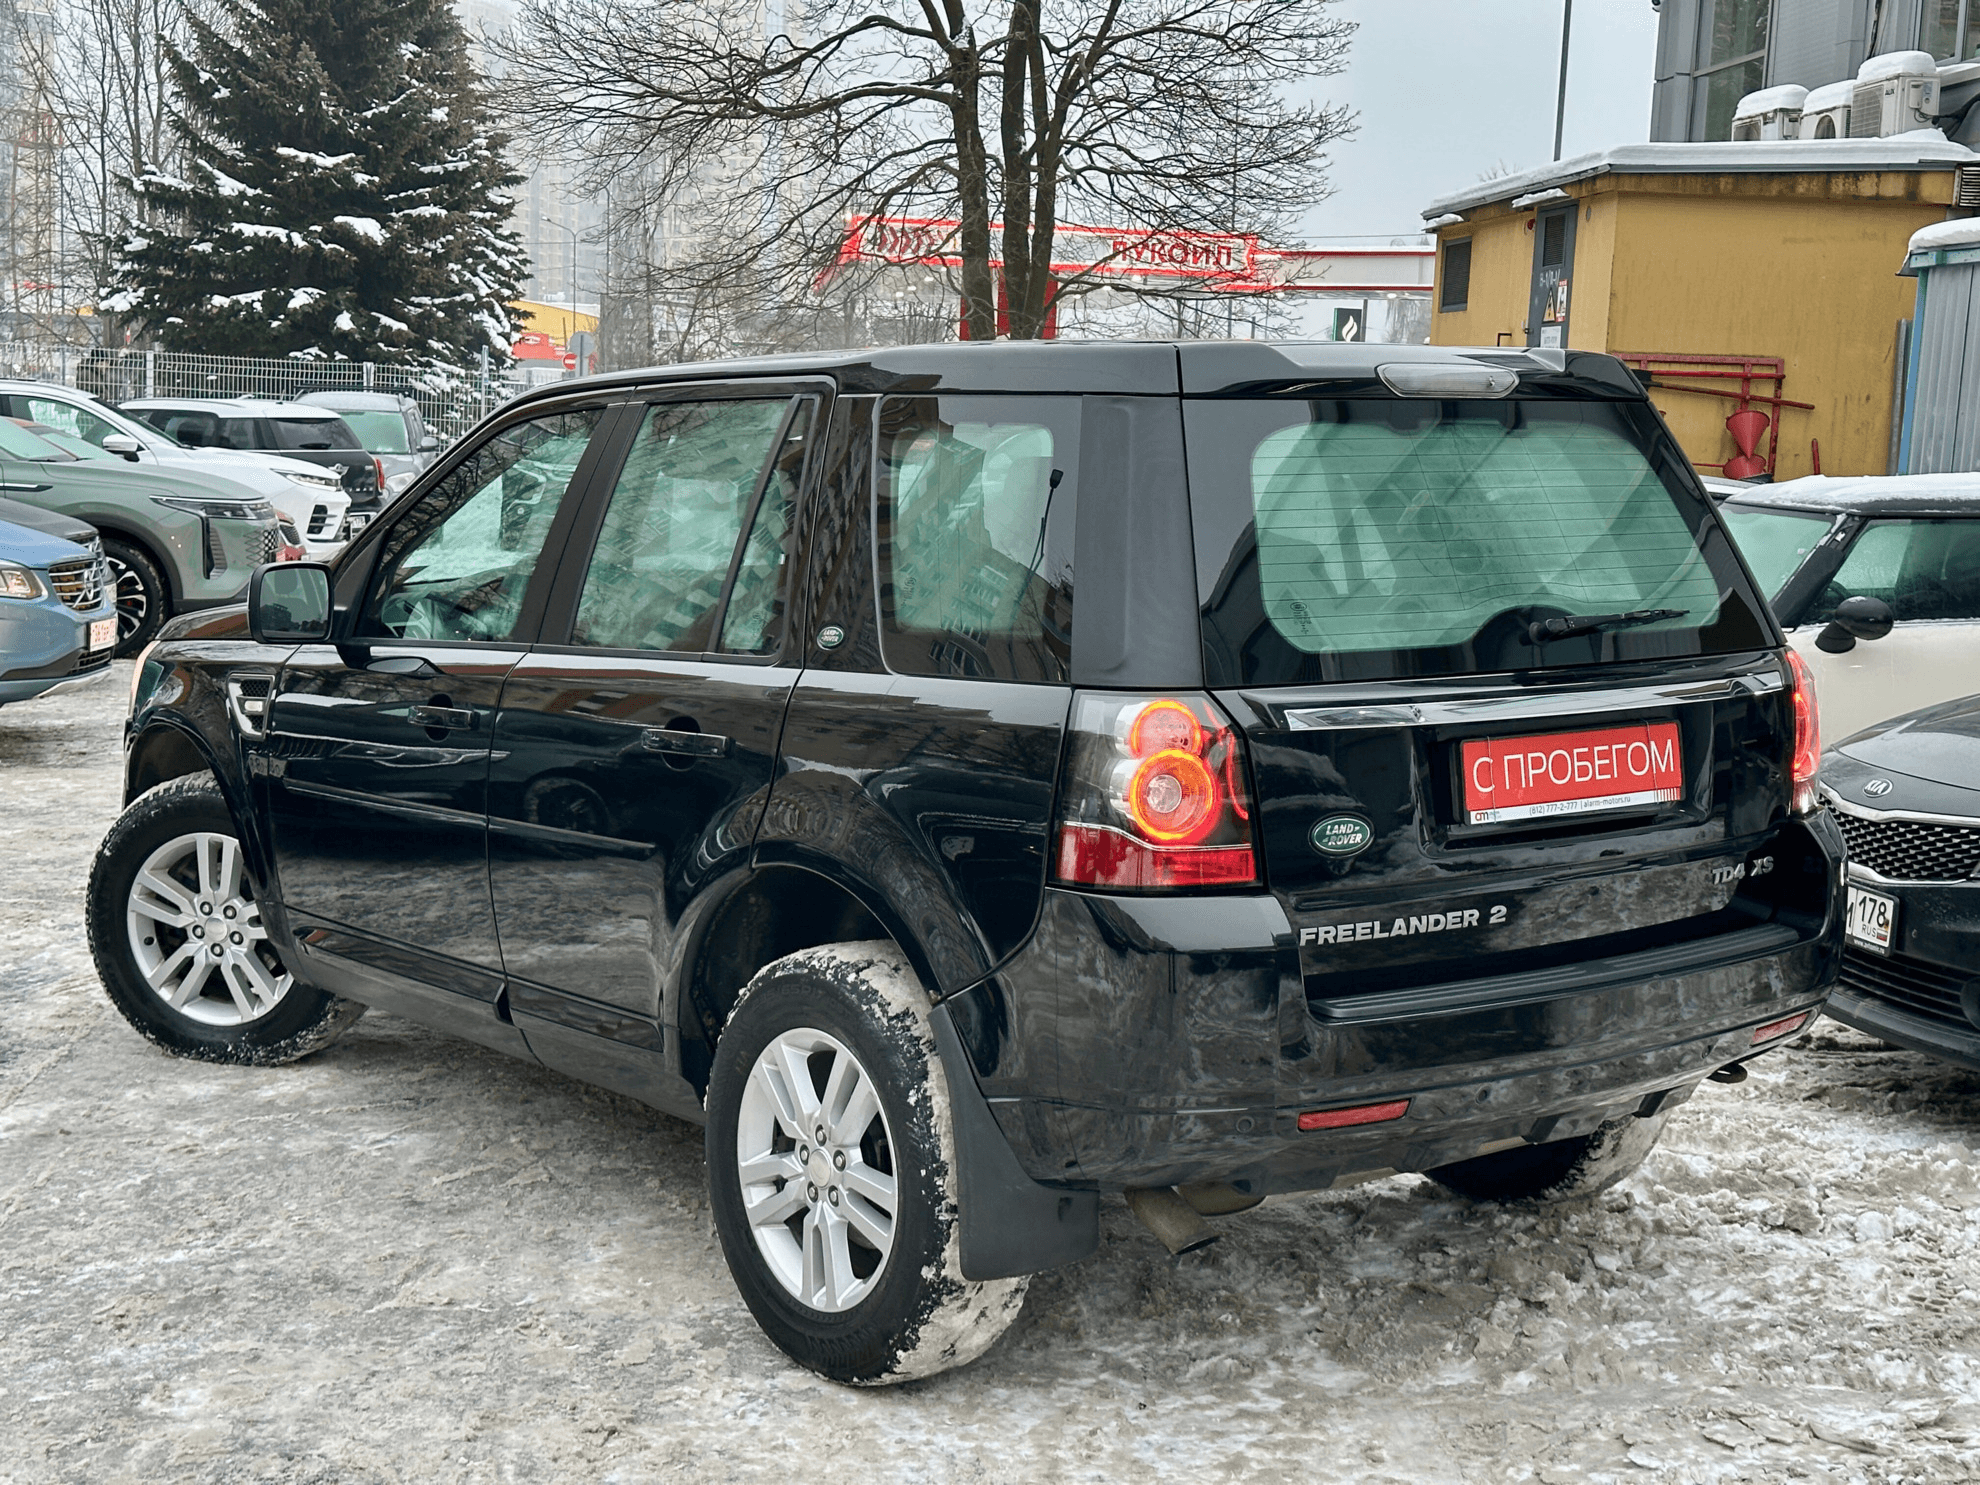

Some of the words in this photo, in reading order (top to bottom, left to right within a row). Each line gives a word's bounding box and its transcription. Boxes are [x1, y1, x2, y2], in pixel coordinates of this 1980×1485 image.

[1472, 756, 1495, 793] С
[1503, 739, 1675, 790] ПРОБЕГОМ
[1864, 779, 1888, 794] KIA
[1529, 805, 1546, 816] (812)
[1546, 801, 1578, 813] 777-2-777
[1584, 796, 1631, 808] alarm-motors.ru
[1327, 833, 1363, 846] ROVER
[1712, 862, 1746, 885] TD4
[1750, 856, 1774, 877] XS
[1859, 895, 1887, 928] 178
[1299, 908, 1481, 947] FREELANDER
[1489, 904, 1508, 925] 2
[1862, 923, 1877, 938] RUS
